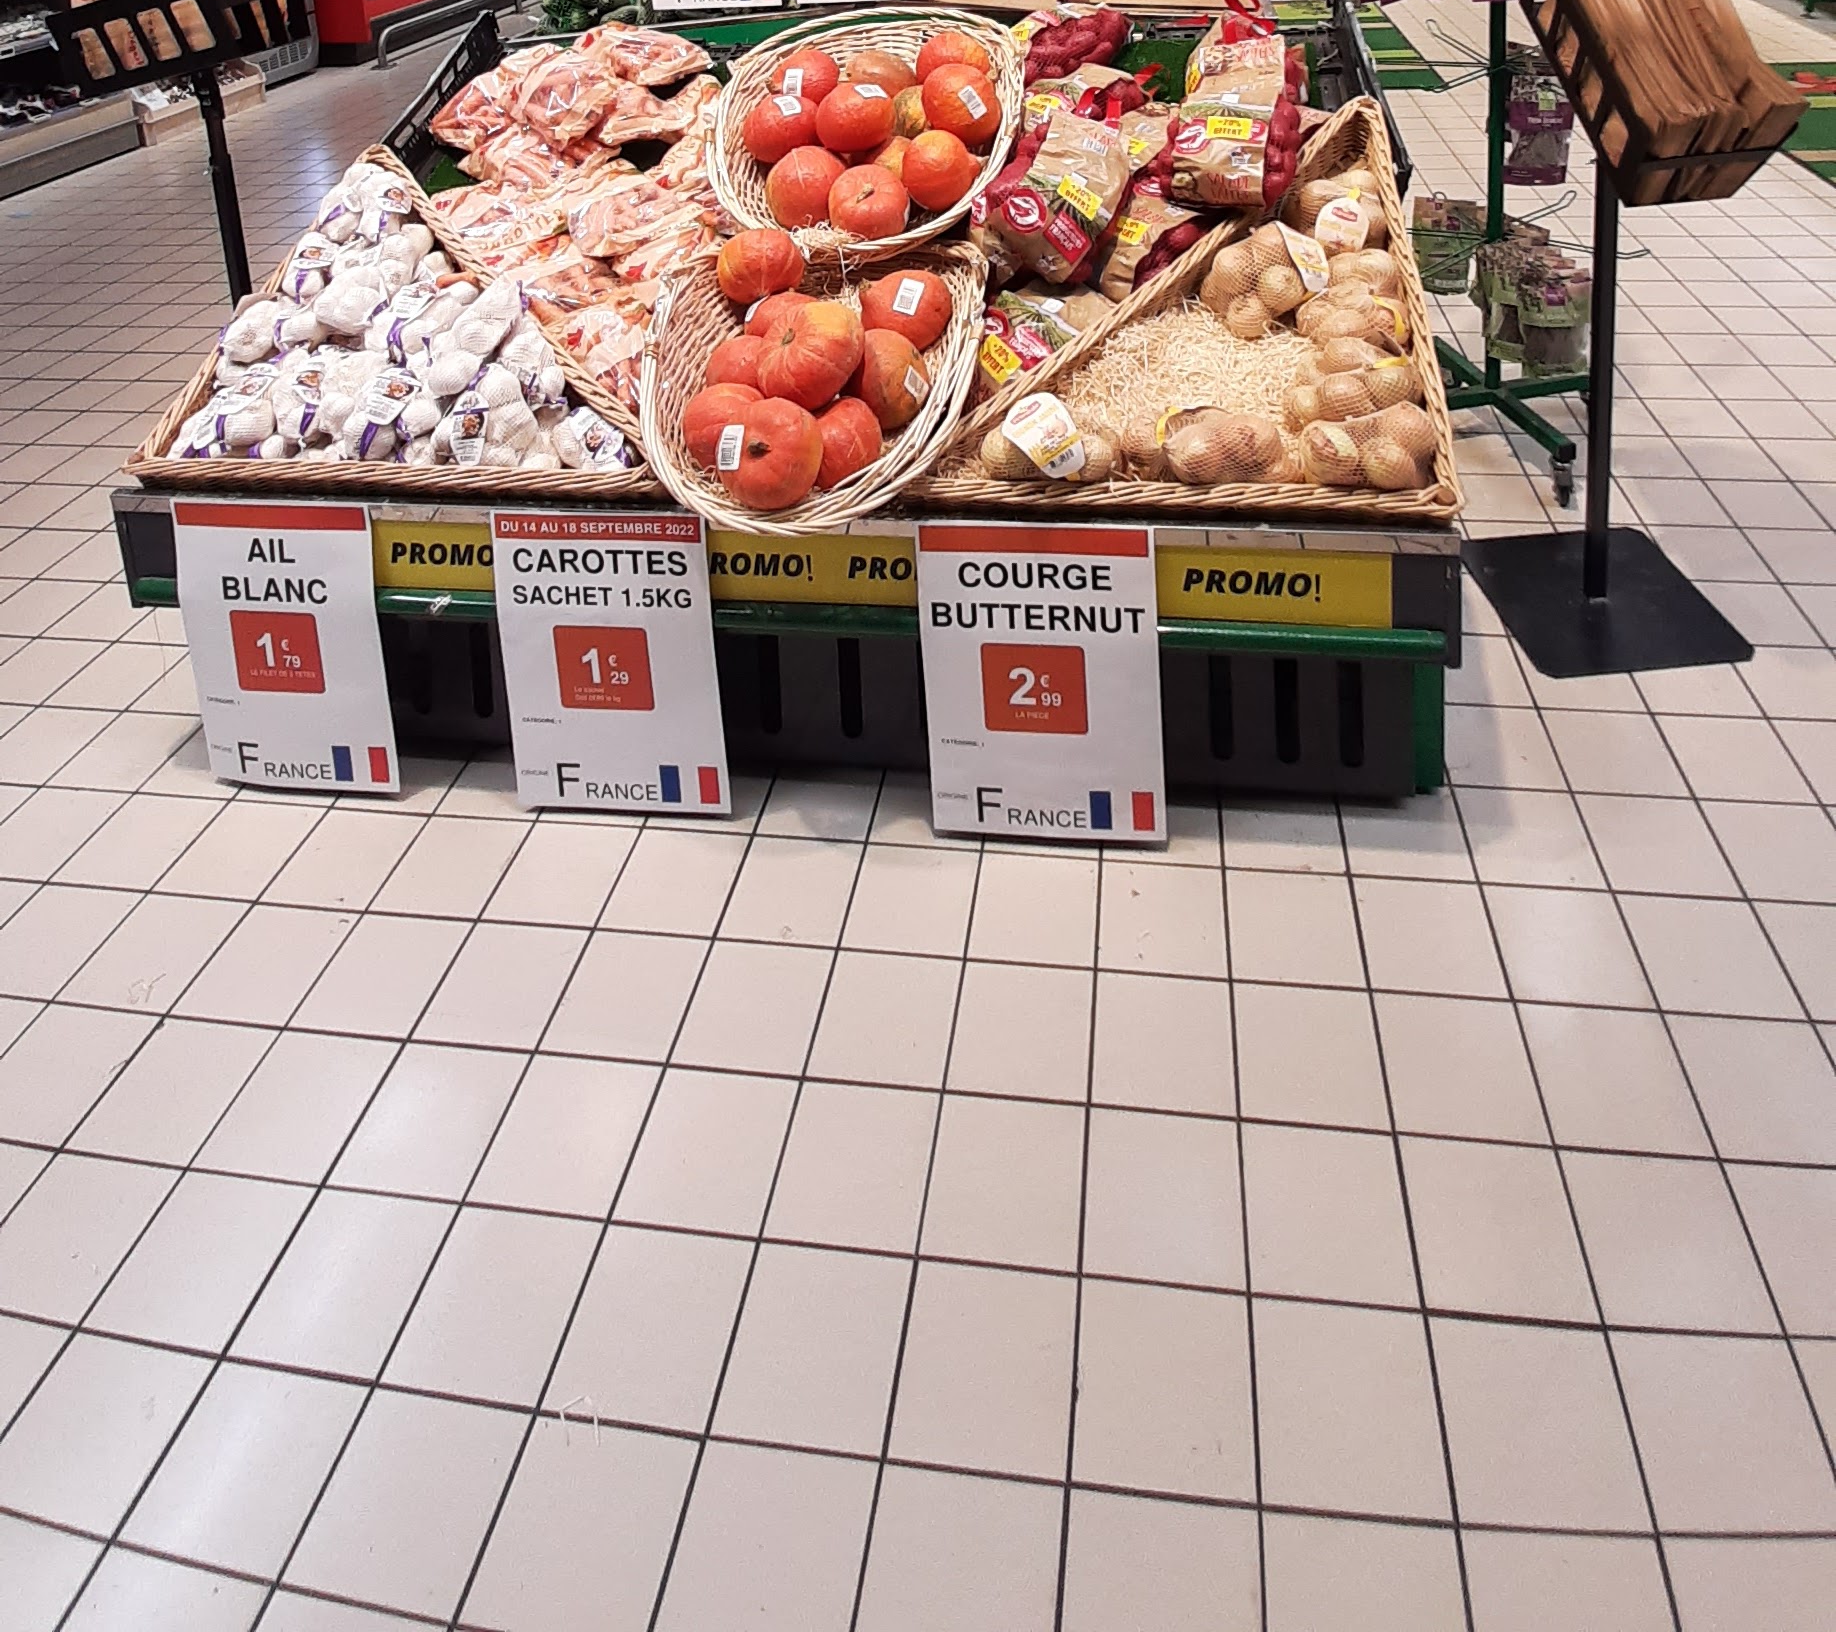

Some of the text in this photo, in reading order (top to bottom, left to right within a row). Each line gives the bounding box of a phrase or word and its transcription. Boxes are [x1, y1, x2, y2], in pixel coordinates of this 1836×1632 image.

[501, 521, 695, 536] DU 14 AU 18 SEPTEMBRE 2022
[248, 538, 296, 564] AIL
[512, 548, 688, 576] CAROTTES
[710, 551, 813, 581] ROMO!
[848, 555, 917, 581] PRO
[958, 561, 1113, 592] COURGE
[222, 576, 328, 604] BLANC
[512, 585, 692, 609] SACHET 1.5KG
[1183, 568, 1321, 602] PROMO!
[931, 601, 1146, 635] BUTTERNUT
[238, 741, 333, 780] FRANCE
[557, 763, 658, 801] FRANCE
[977, 786, 1087, 829] FRANCE
